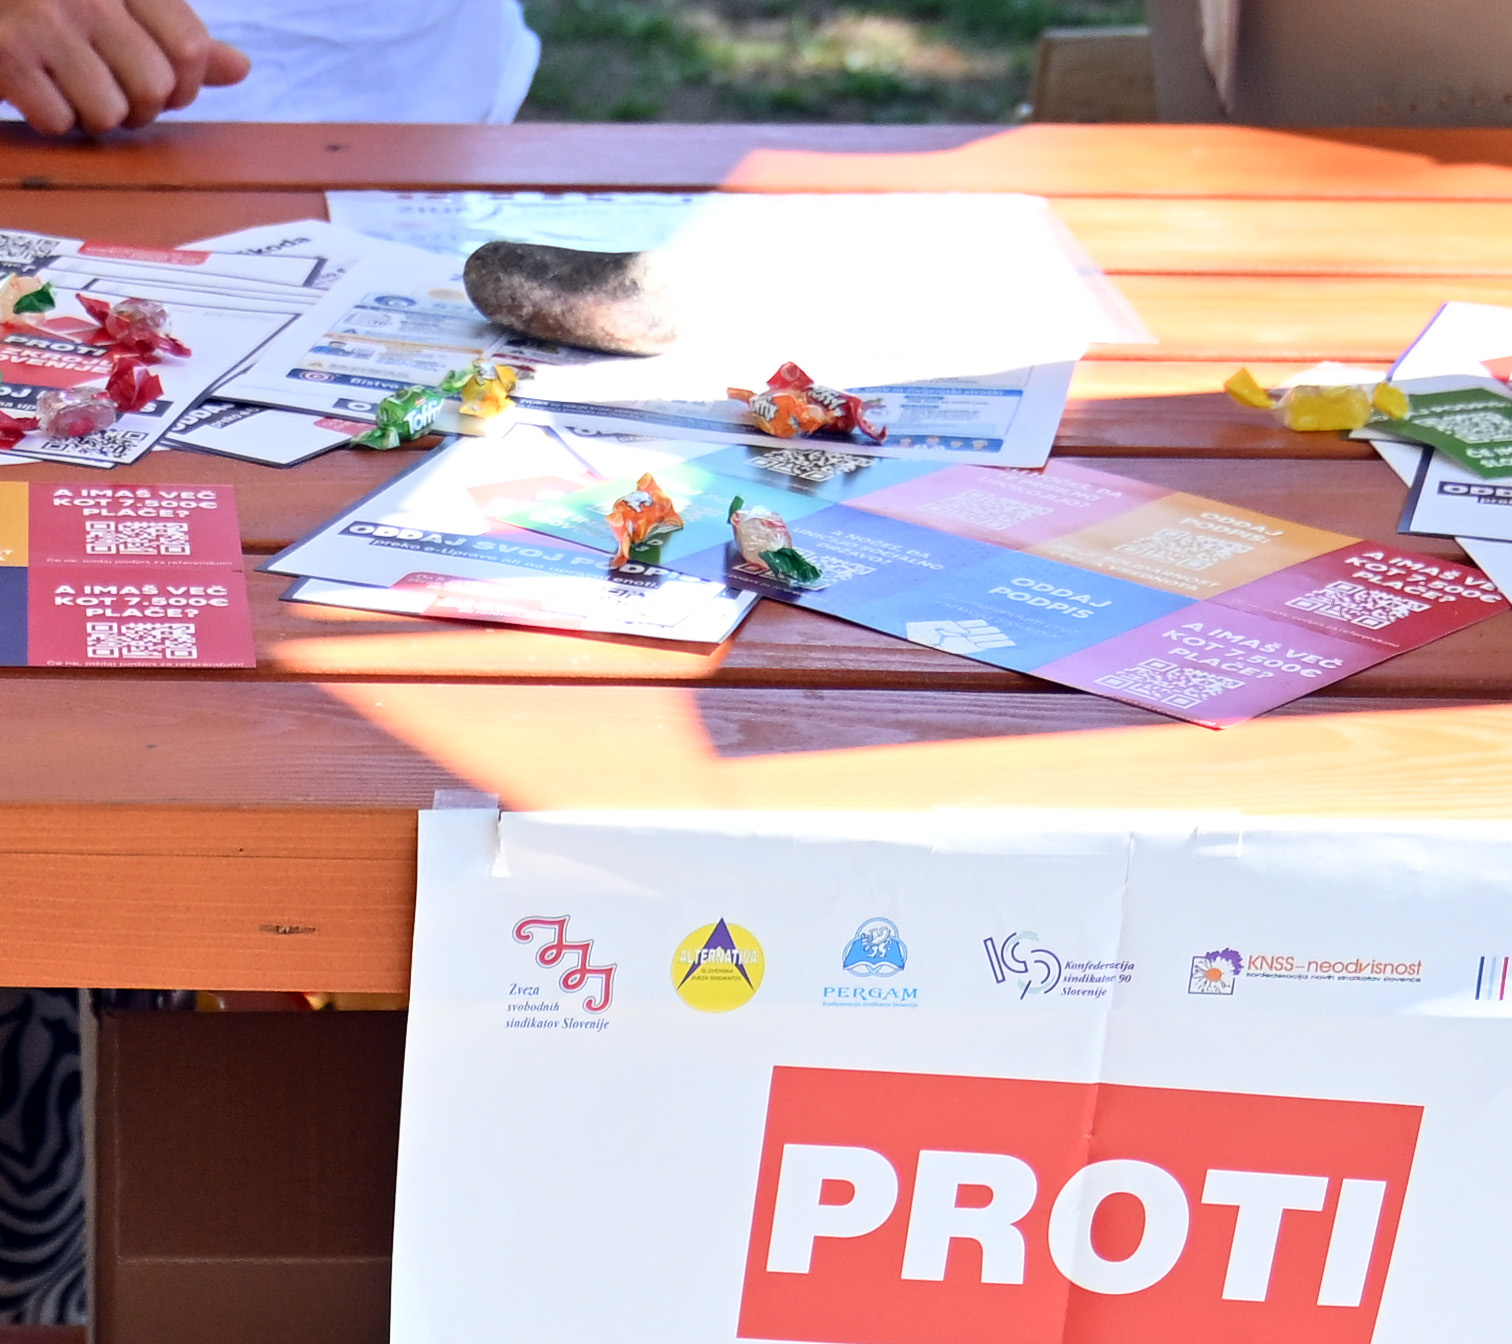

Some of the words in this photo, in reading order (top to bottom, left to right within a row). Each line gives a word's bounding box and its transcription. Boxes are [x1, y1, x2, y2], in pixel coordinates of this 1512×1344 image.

[55, 586, 76, 595] A
[83, 585, 158, 595] IMAŠ
[163, 584, 228, 596] VEČ
[55, 597, 120, 606] KOT
[124, 597, 229, 607] 7.500€
[86, 606, 199, 618] PLAČE?
[1163, 630, 1225, 651] KOT
[1228, 648, 1324, 678] 7.500€
[1183, 622, 1203, 632] A
[1208, 628, 1282, 653] IMAŠ
[1287, 649, 1344, 669] VEČ
[1168, 648, 1274, 679] PLAČE?
[767, 1144, 1386, 1307] PROTI
